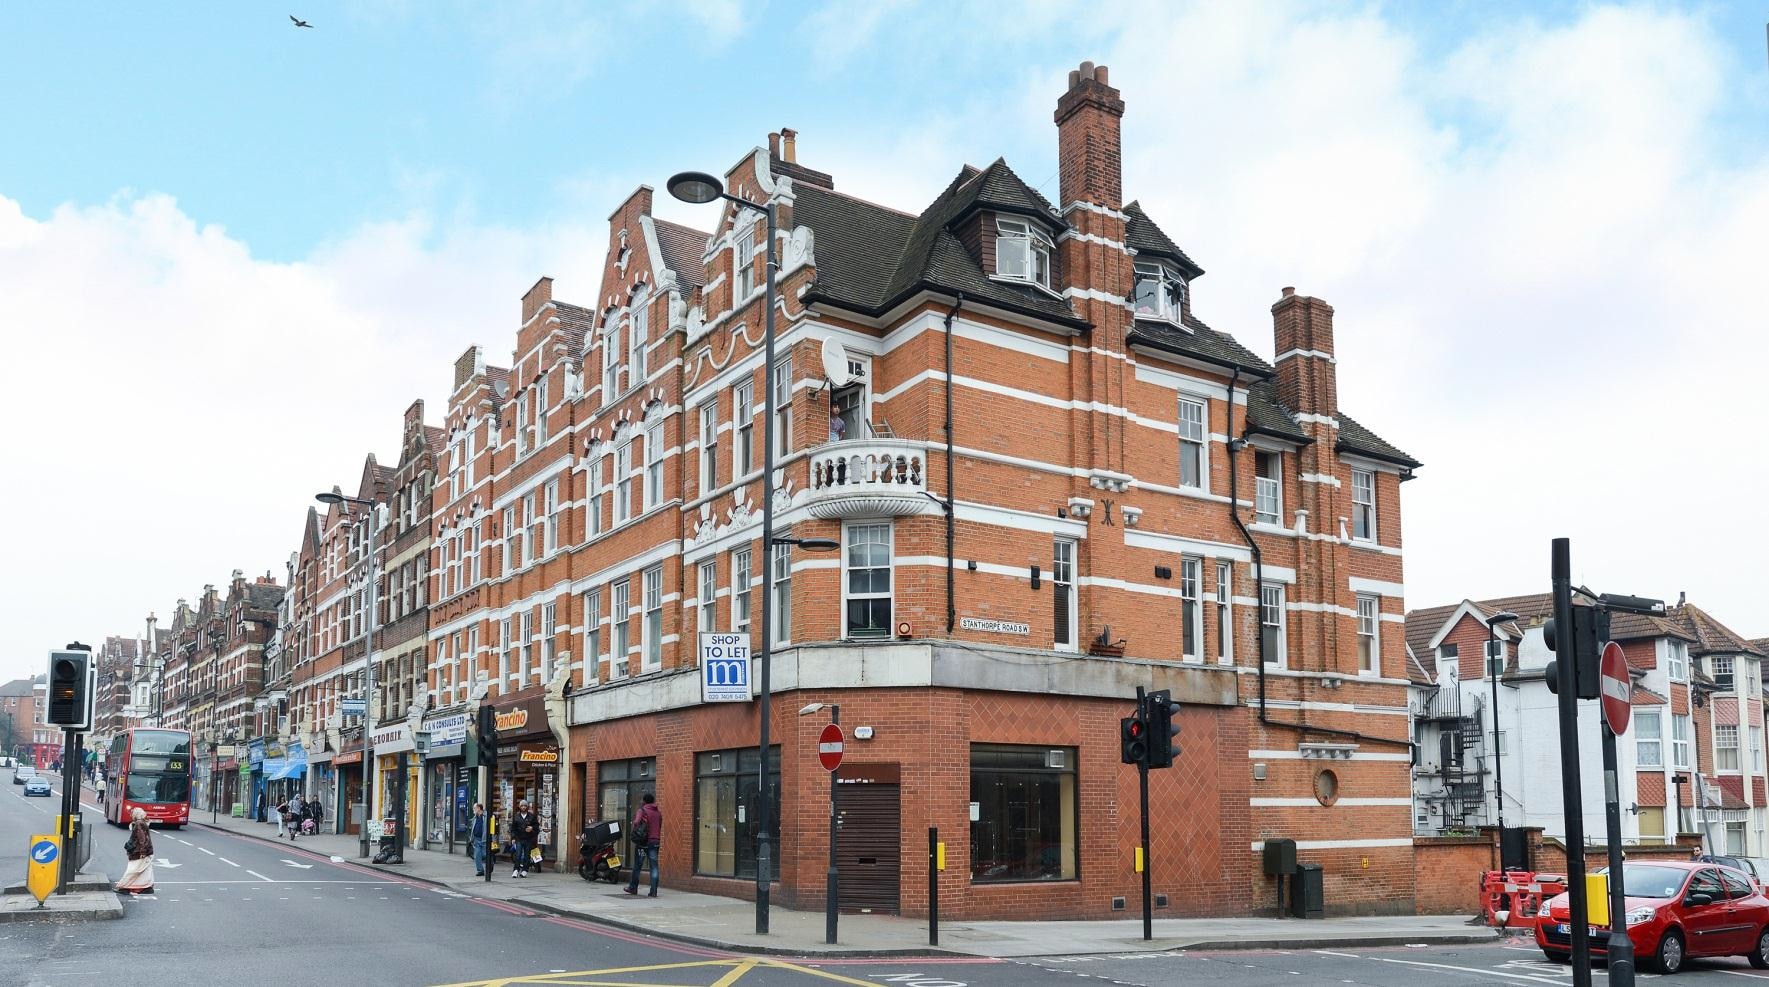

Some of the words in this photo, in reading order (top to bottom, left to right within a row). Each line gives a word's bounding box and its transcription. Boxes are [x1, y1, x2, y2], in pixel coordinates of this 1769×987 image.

[963, 620, 1000, 630] STANTHORPE
[1002, 624, 1018, 632] ROAD
[711, 636, 740, 645] SHOP
[705, 647, 722, 658] TO
[728, 647, 747, 658] LET
[436, 717, 457, 729] CONSULTS
[457, 715, 465, 725] LTD
[521, 751, 557, 760] Francino
